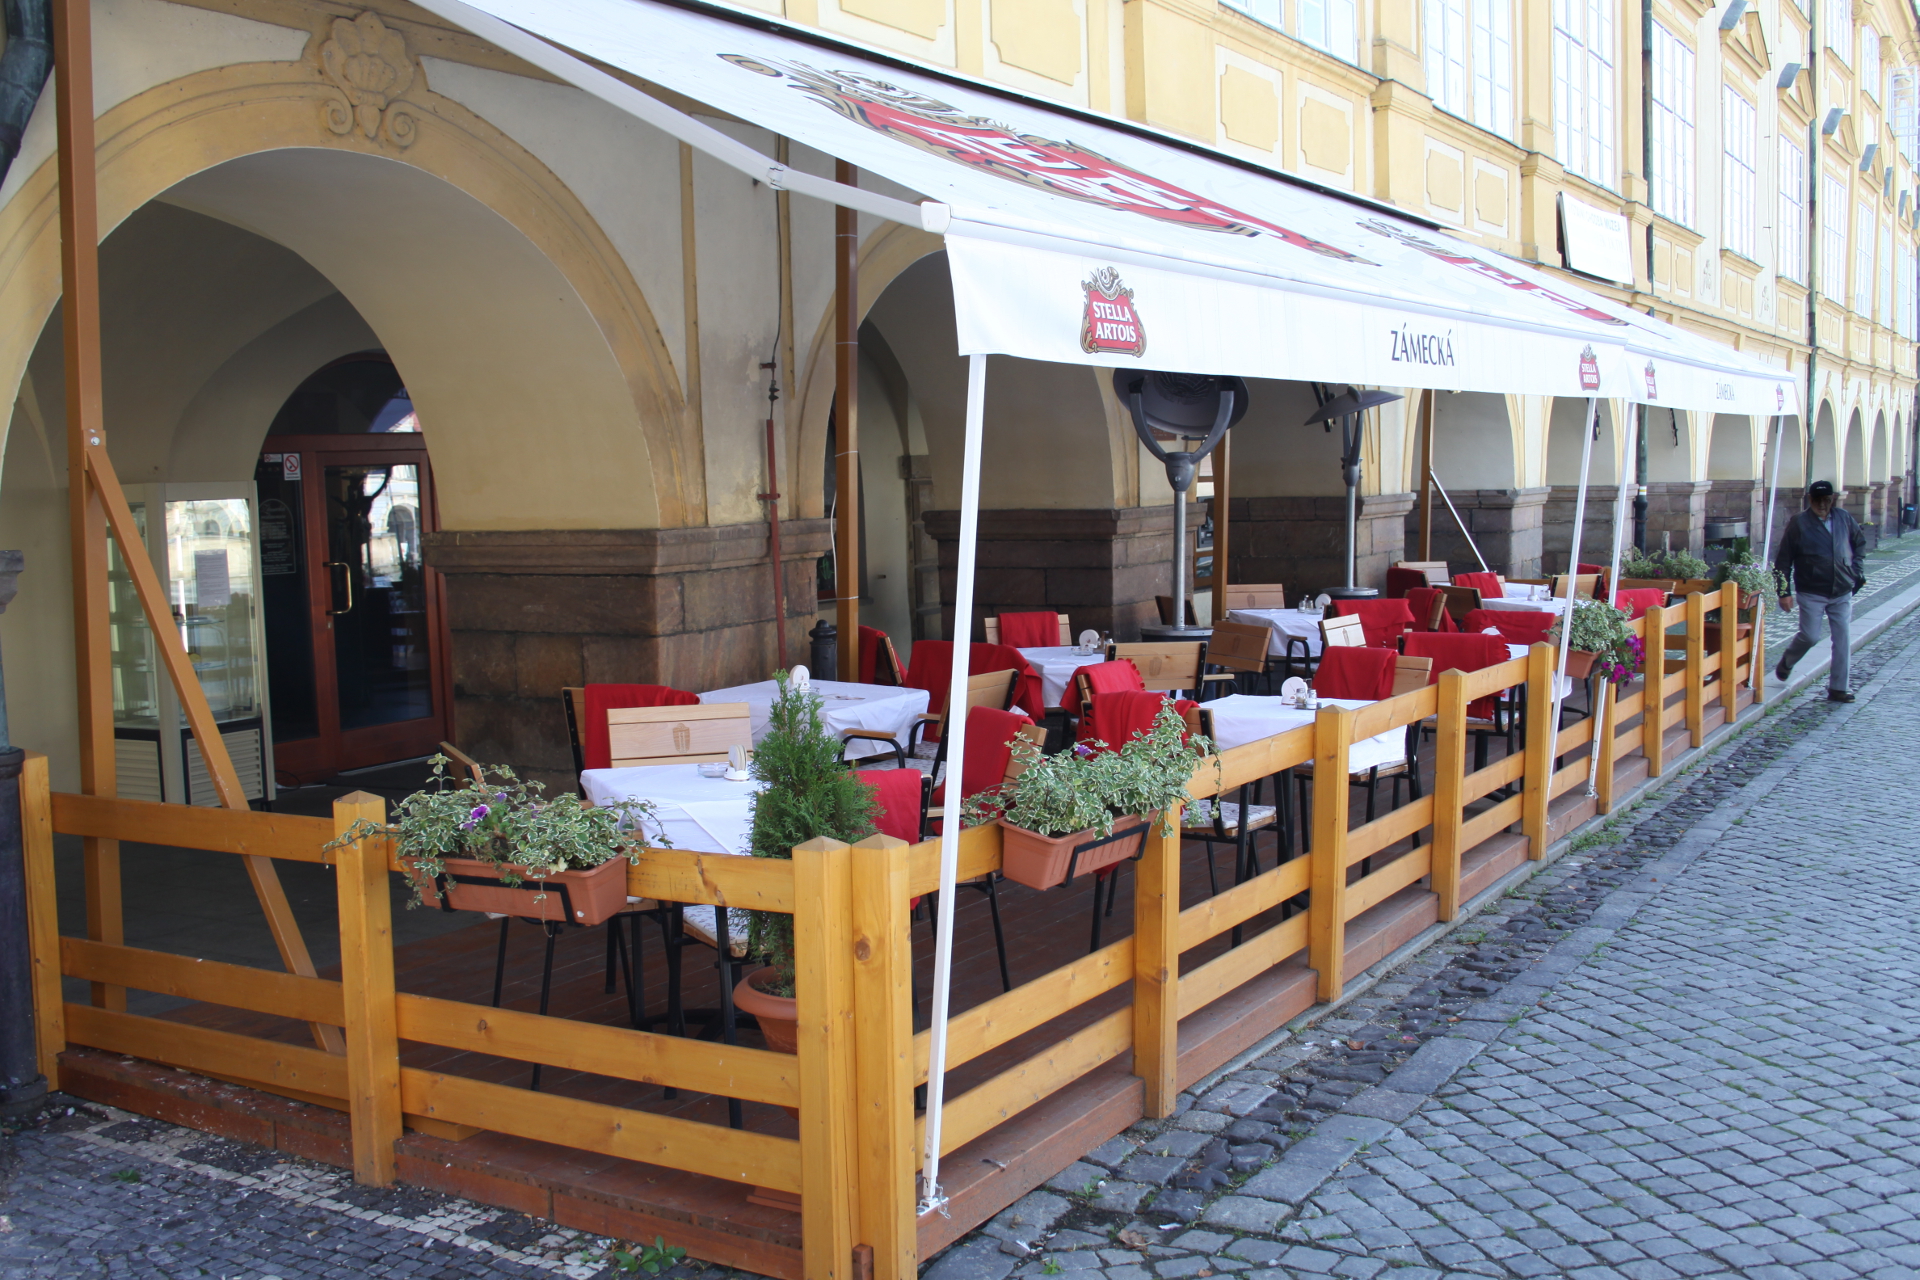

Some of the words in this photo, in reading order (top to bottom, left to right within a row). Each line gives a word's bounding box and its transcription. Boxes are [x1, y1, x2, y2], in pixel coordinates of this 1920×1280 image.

[1604, 218, 1621, 232] MUZEA
[1092, 301, 1134, 323] STELLA
[1095, 321, 1137, 343] ARTOIS
[1390, 321, 1455, 367] ZÁMECKÁ
